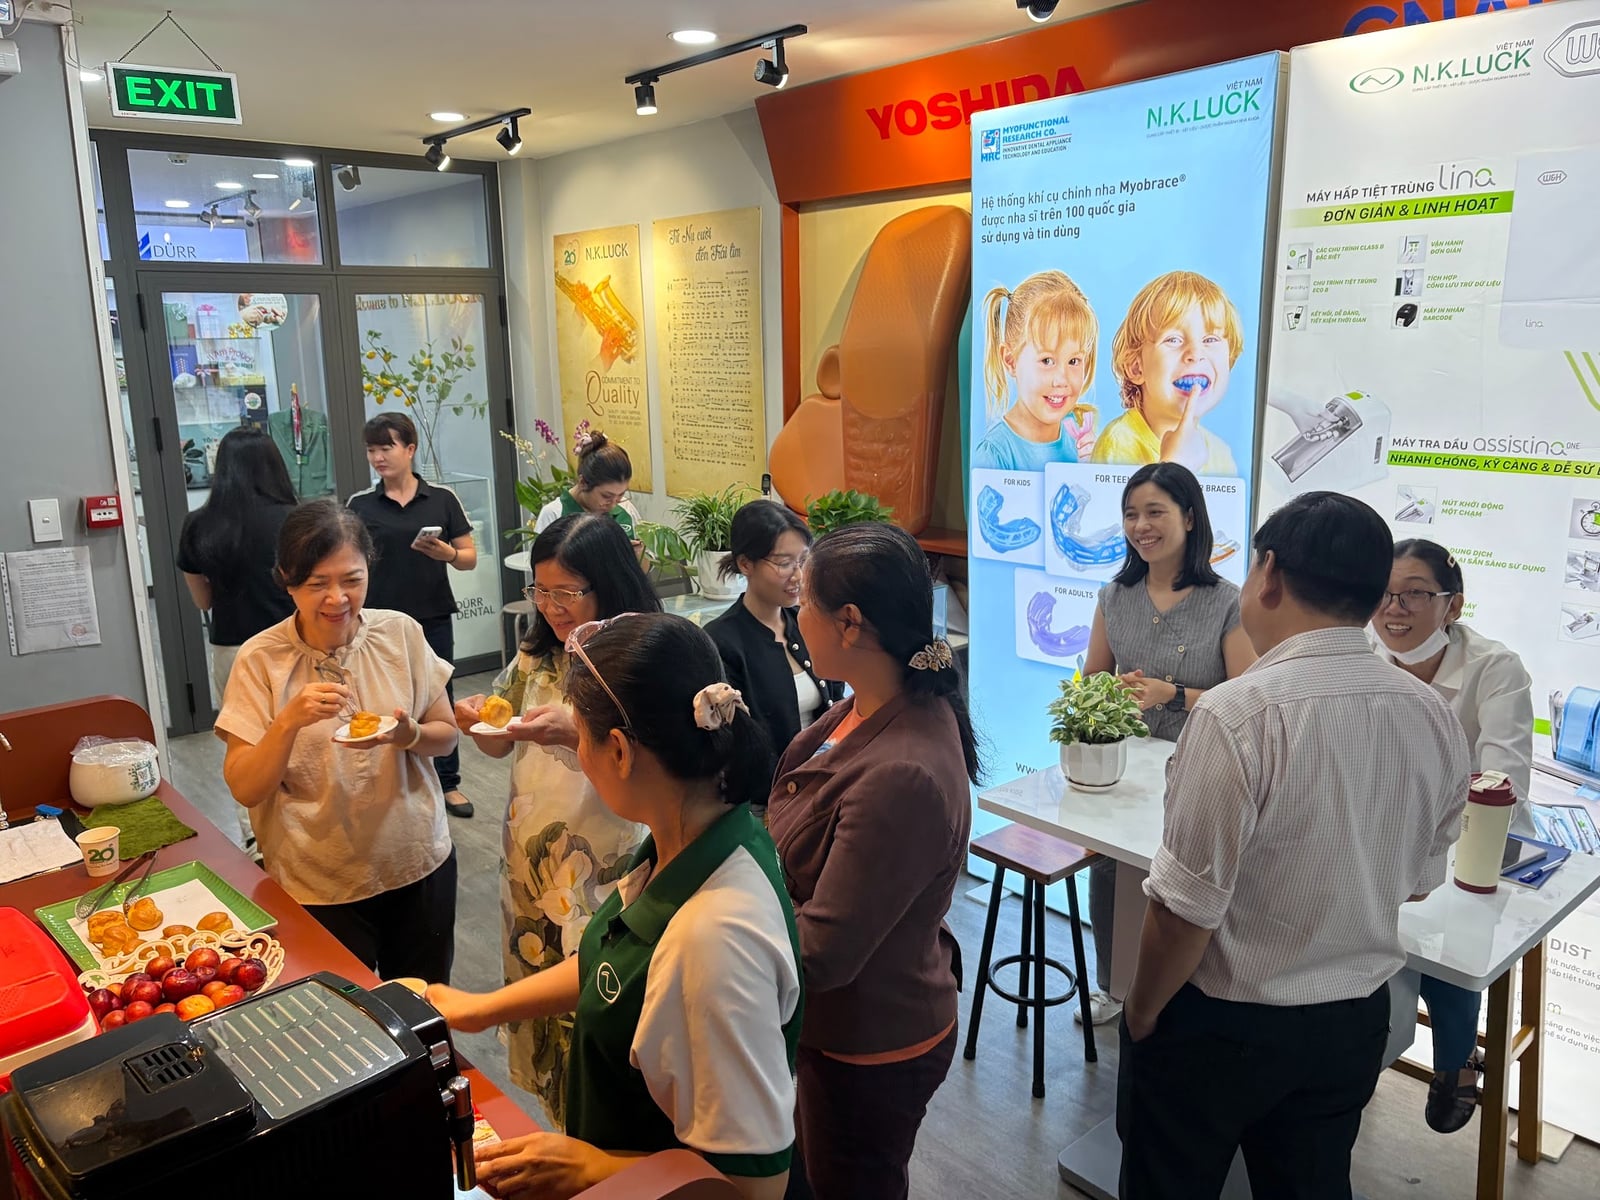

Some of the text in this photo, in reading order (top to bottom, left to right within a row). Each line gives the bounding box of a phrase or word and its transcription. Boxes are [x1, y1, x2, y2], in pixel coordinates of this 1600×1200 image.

[1496, 39, 1534, 51] VIỆT NAM
[1566, 33, 1600, 65] W
[1412, 48, 1532, 84] N.K.LUCK
[1226, 77, 1263, 91] VIỆT NAM
[125, 75, 222, 111] EXIT
[866, 66, 1086, 140] YOSHIDA
[1146, 88, 1261, 129] N.K.LUCK
[1002, 115, 1070, 134] MYOFUNCTIONAL
[1002, 128, 1057, 143] RESEARCH CO.
[1002, 137, 1072, 153] INNOVATIVE DENTAL APPLIANCE
[981, 152, 1000, 162] MRC
[1002, 151, 1030, 160] TECHNOLOGY
[1041, 146, 1067, 154] EDUCATION
[1438, 164, 1496, 190] lina
[981, 196, 994, 211] Hệ
[997, 193, 1025, 208] thống
[1028, 190, 1044, 204] khí
[1046, 192, 1059, 205] cụ
[1095, 184, 1116, 197] nha
[1306, 181, 1435, 203] MÁY HẤP TIỆT TRÙNG
[981, 200, 1136, 228] được nha sĩ trên 100 quốc gia
[1323, 197, 1499, 222] ĐƠN GIẢN & LINH HOẠT
[981, 224, 1080, 245] sử dụng và tin dùng
[153, 242, 197, 258] DÜRR
[585, 243, 628, 260] N.K.LUCK
[356, 295, 386, 311] lcome
[585, 370, 640, 416] Quality
[1392, 437, 1416, 448] MÁY
[1419, 439, 1441, 449] TRA
[1473, 435, 1567, 456] assistina
[1390, 454, 1431, 465] NHANH
[1434, 455, 1480, 469] CHÓNG,
[1483, 458, 1501, 469] KỸ
[1502, 460, 1538, 472] CÀNG
[1540, 462, 1550, 472] &
[1553, 460, 1571, 473] DỄ
[1574, 463, 1595, 475] SỬ
[1003, 478, 1031, 487] FOR KIDS
[1095, 474, 1131, 484] FOR TEE
[1206, 484, 1236, 493] BRACES
[1441, 499, 1504, 511] NÚT KHỞI ĐỘNG
[1441, 508, 1483, 518] MỘT CHẠM
[1473, 550, 1493, 558] DỊCH
[1522, 564, 1546, 573] DỤNG
[1054, 587, 1094, 599] FOR ADULTS
[456, 597, 483, 610] DÜRR
[456, 605, 496, 620] DENTAL
[1015, 762, 1038, 774] ww
[88, 848, 114, 861] 20
[1550, 938, 1591, 960] DIST
[1560, 962, 1580, 973] nước
[1565, 1026, 1580, 1036] cho
[1590, 1046, 1600, 1054] ch
